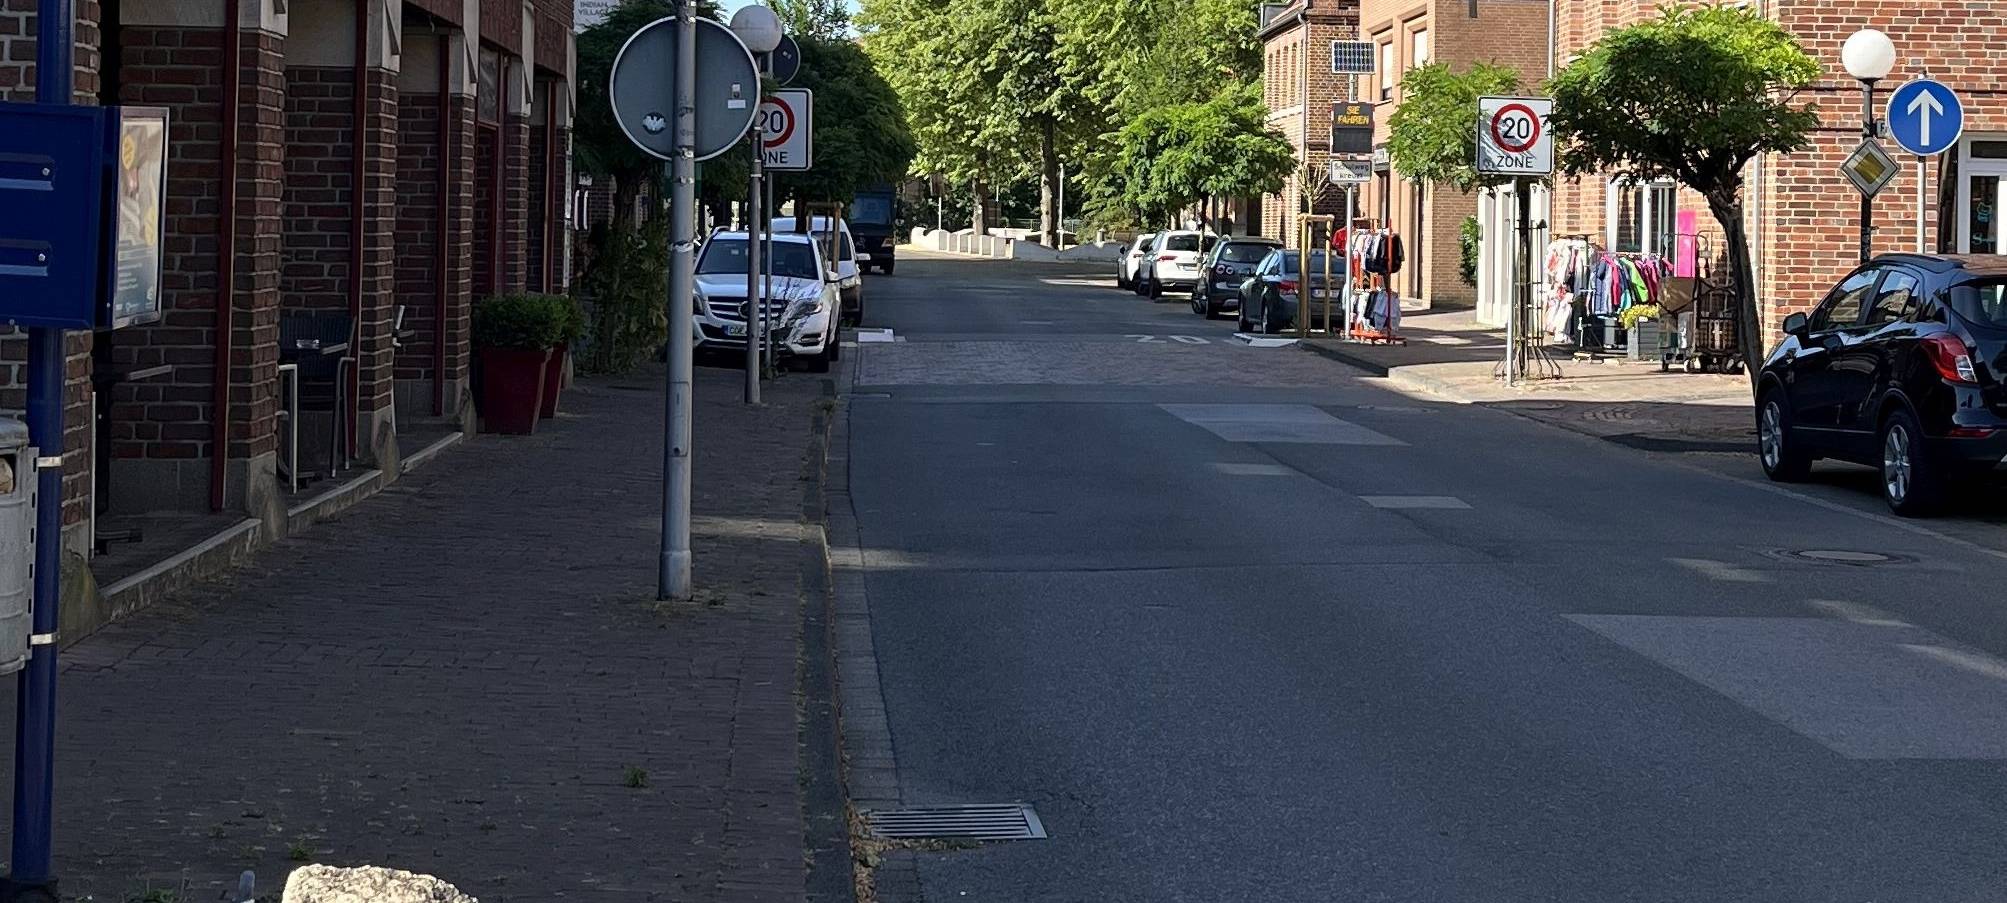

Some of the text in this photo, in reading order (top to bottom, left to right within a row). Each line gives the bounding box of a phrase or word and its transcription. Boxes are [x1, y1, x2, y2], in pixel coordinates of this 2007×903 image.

[1346, 105, 1361, 114] SIE
[1338, 115, 1369, 125] FAHREN
[1503, 117, 1529, 139] 20
[1497, 155, 1534, 168] ZONE
